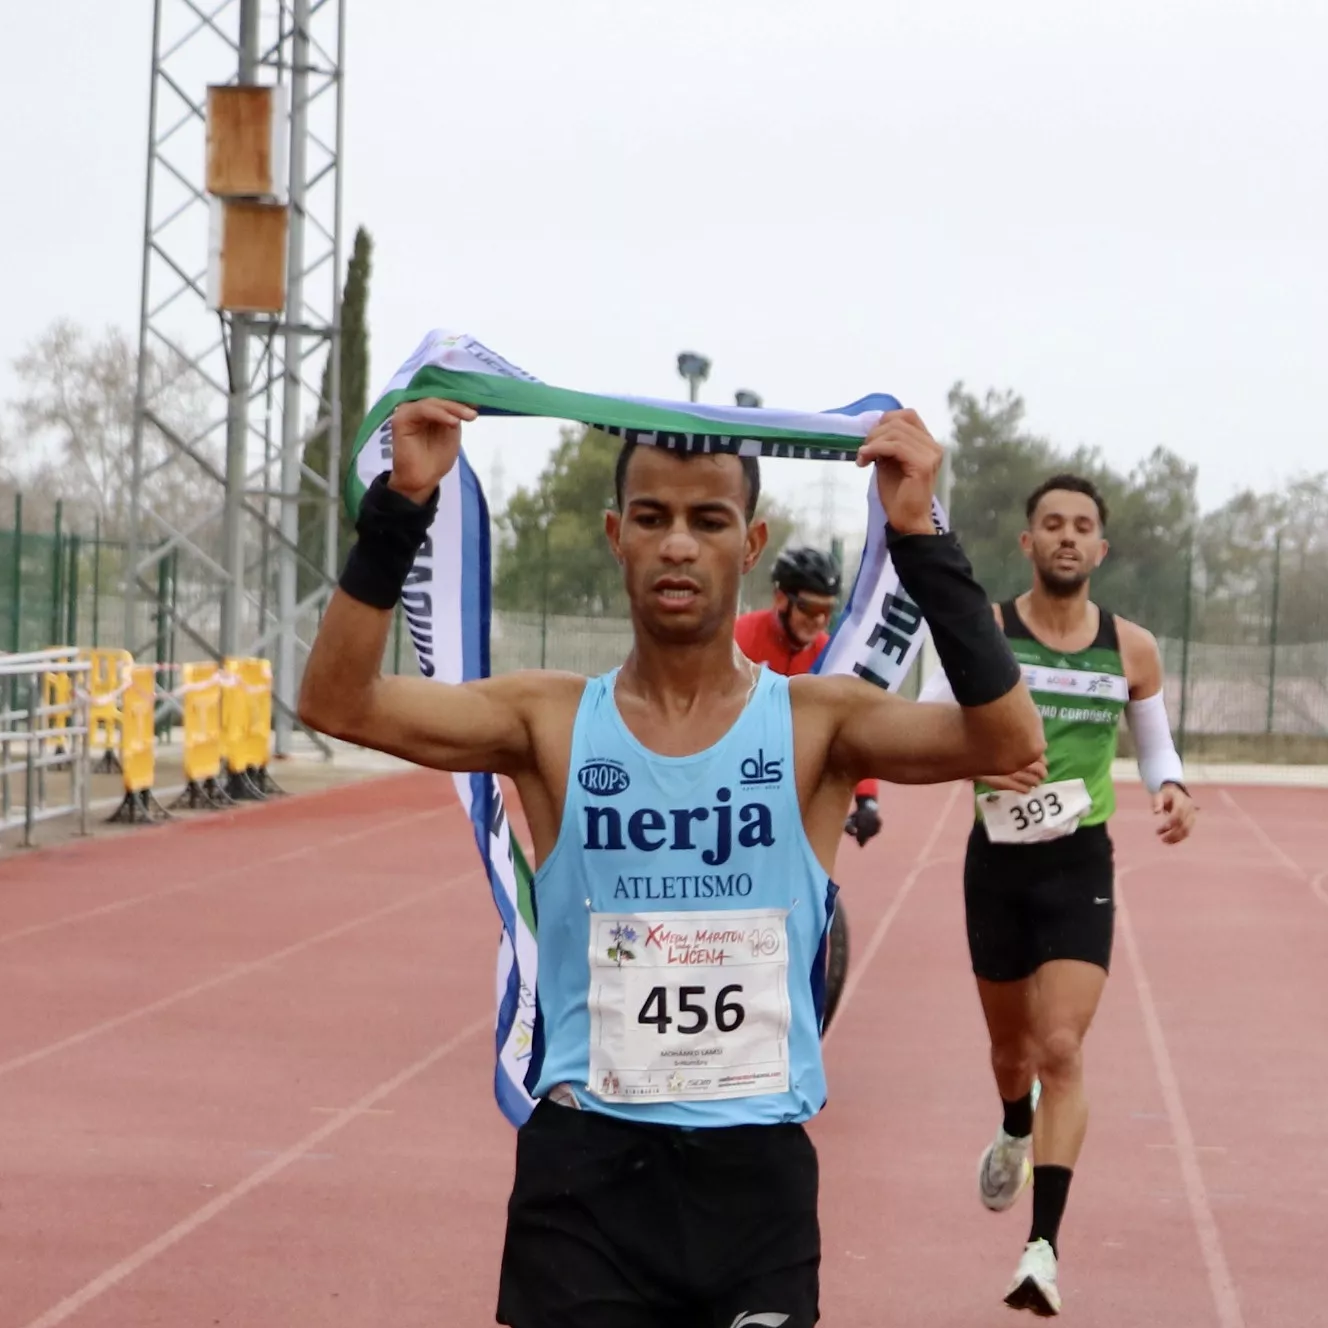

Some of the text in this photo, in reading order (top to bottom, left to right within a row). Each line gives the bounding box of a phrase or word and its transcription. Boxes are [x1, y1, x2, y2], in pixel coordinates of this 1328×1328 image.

[866, 592, 922, 666] DE
[580, 764, 629, 791] TROPS
[583, 786, 776, 866] nerja
[1009, 792, 1063, 831] 393
[613, 872, 753, 900] ATLETISMO
[667, 944, 734, 966] LUCENA
[637, 983, 746, 1035] 456
